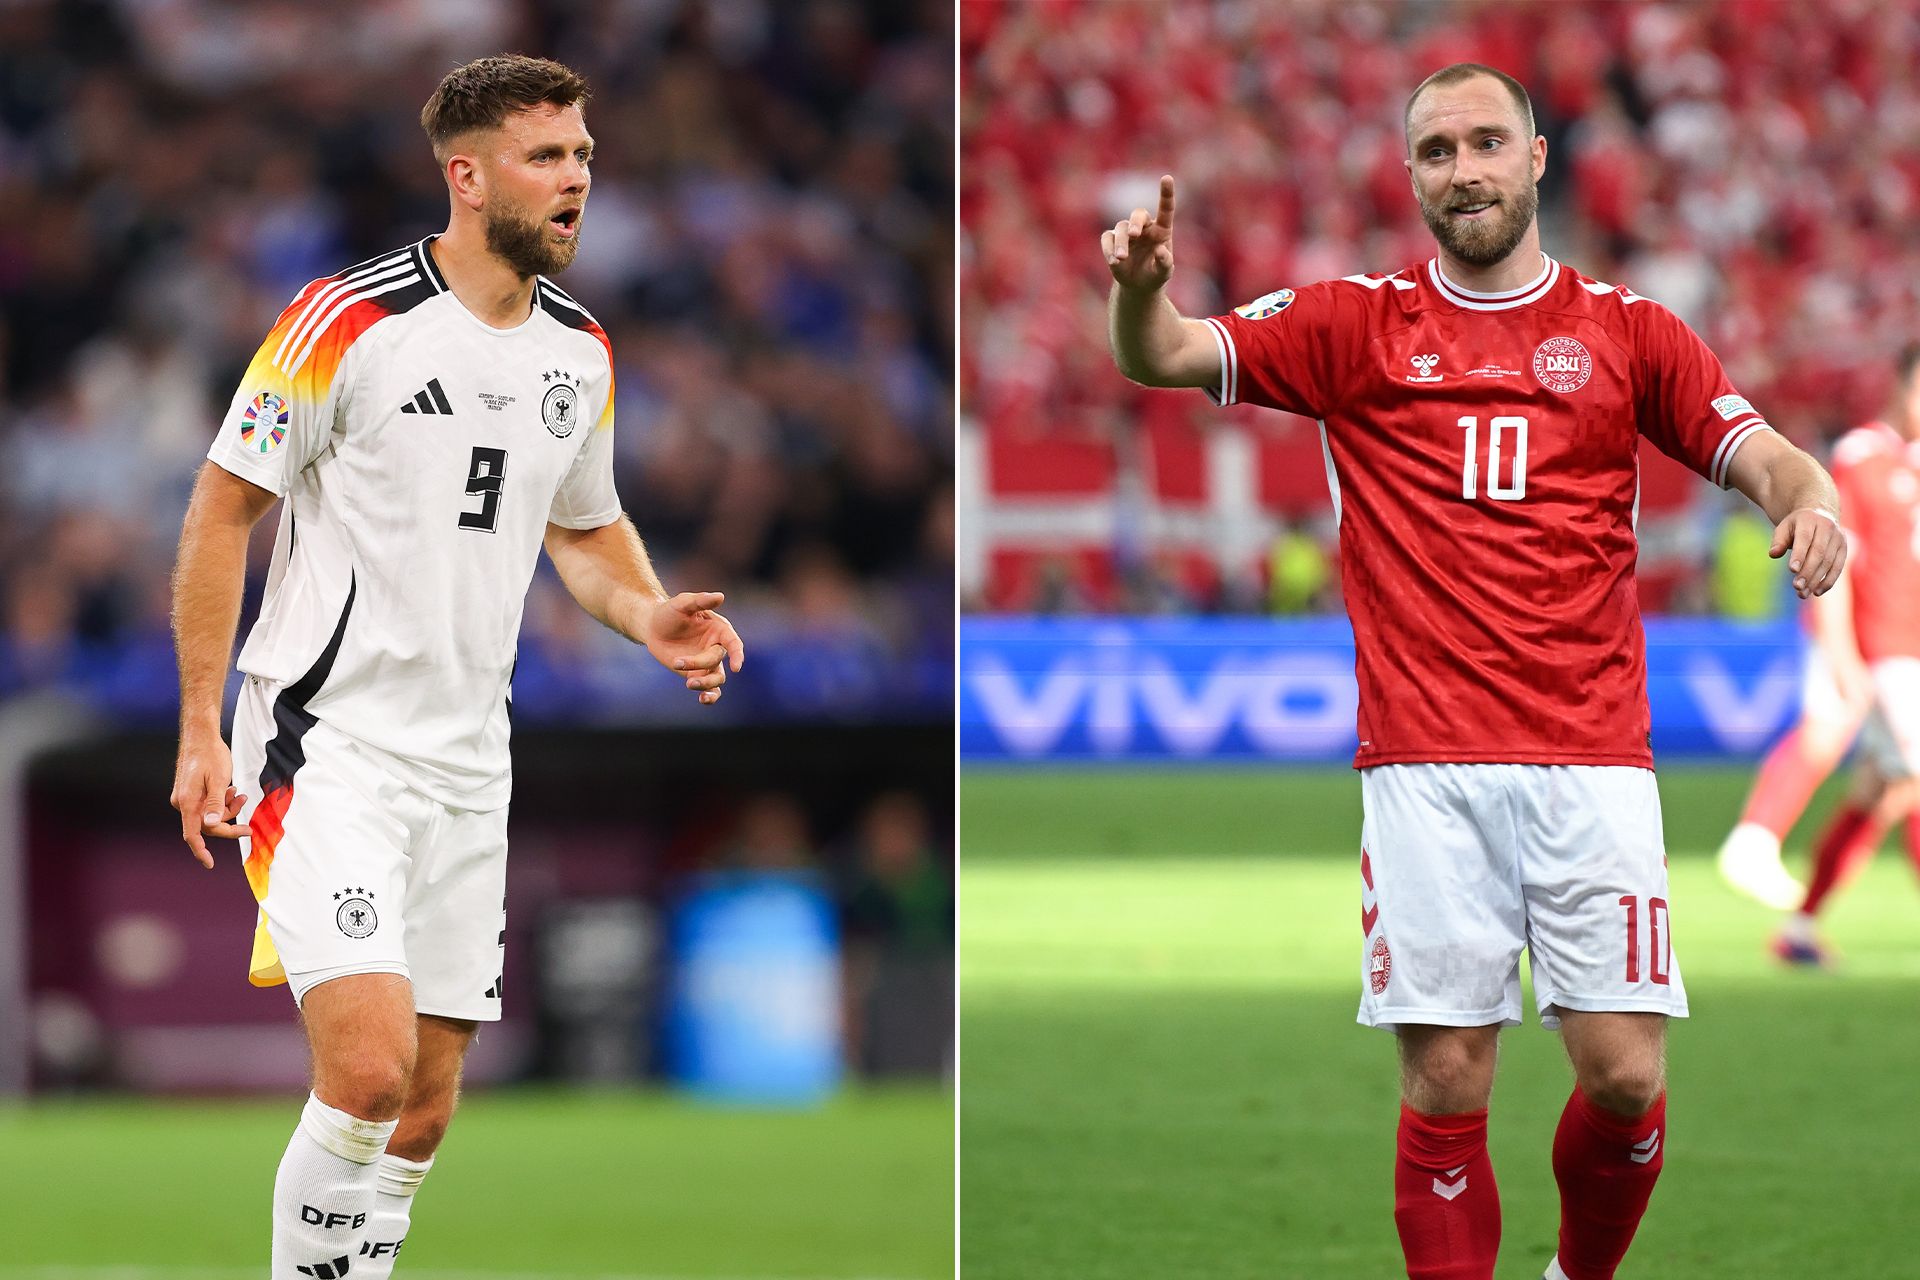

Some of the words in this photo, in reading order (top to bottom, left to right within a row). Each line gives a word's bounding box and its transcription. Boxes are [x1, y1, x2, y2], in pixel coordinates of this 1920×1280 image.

[1535, 352, 1551, 384] DANSK
[1545, 355, 1580, 372] DBU
[1577, 354, 1591, 385] UNION
[1552, 383, 1576, 391] 1889
[1457, 415, 1529, 500] 10
[457, 446, 508, 534] 9
[974, 630, 1358, 753] vivo
[1618, 895, 1671, 986] 10
[301, 1204, 366, 1230] DFB
